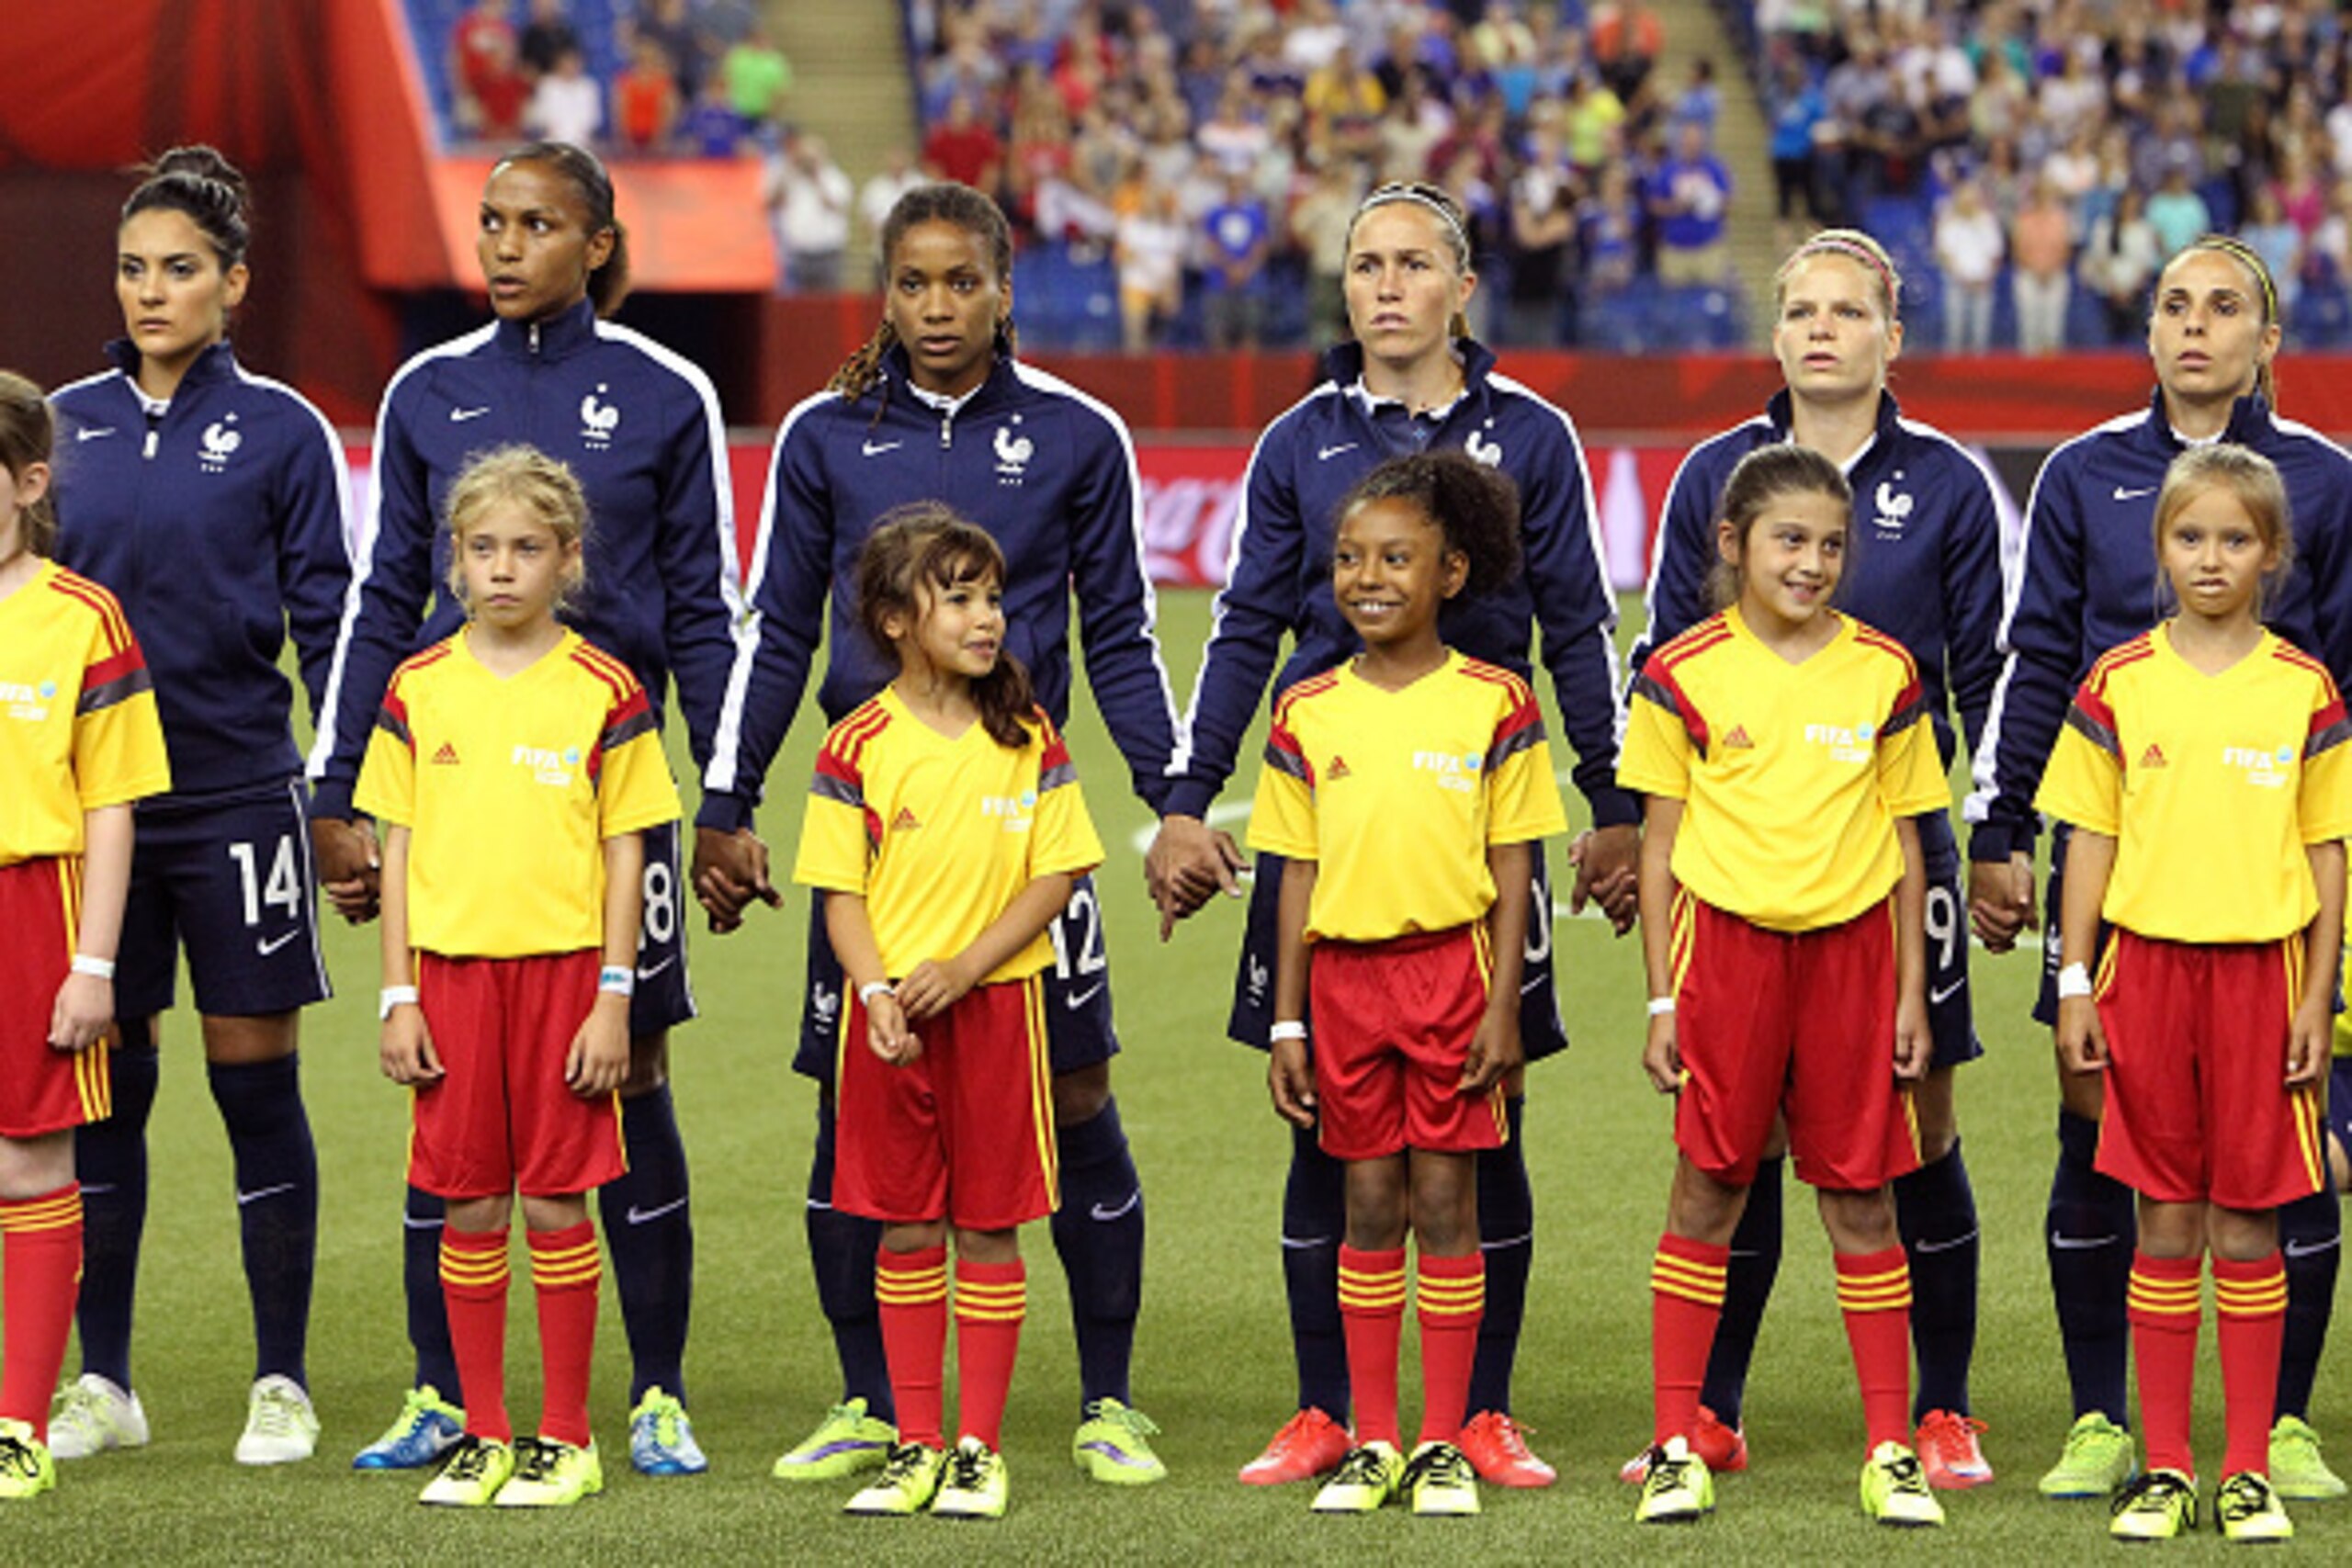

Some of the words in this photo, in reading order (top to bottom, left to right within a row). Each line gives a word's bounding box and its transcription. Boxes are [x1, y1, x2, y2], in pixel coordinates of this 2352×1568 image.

[512, 744, 560, 769] FIFA
[1804, 723, 1853, 745] FIFA
[2223, 746, 2274, 769] FIFA
[1412, 751, 1460, 773] FIFA
[230, 834, 301, 926] 14
[638, 862, 674, 951] 8
[1049, 889, 1106, 979] 12
[1925, 894, 1956, 970] 9
